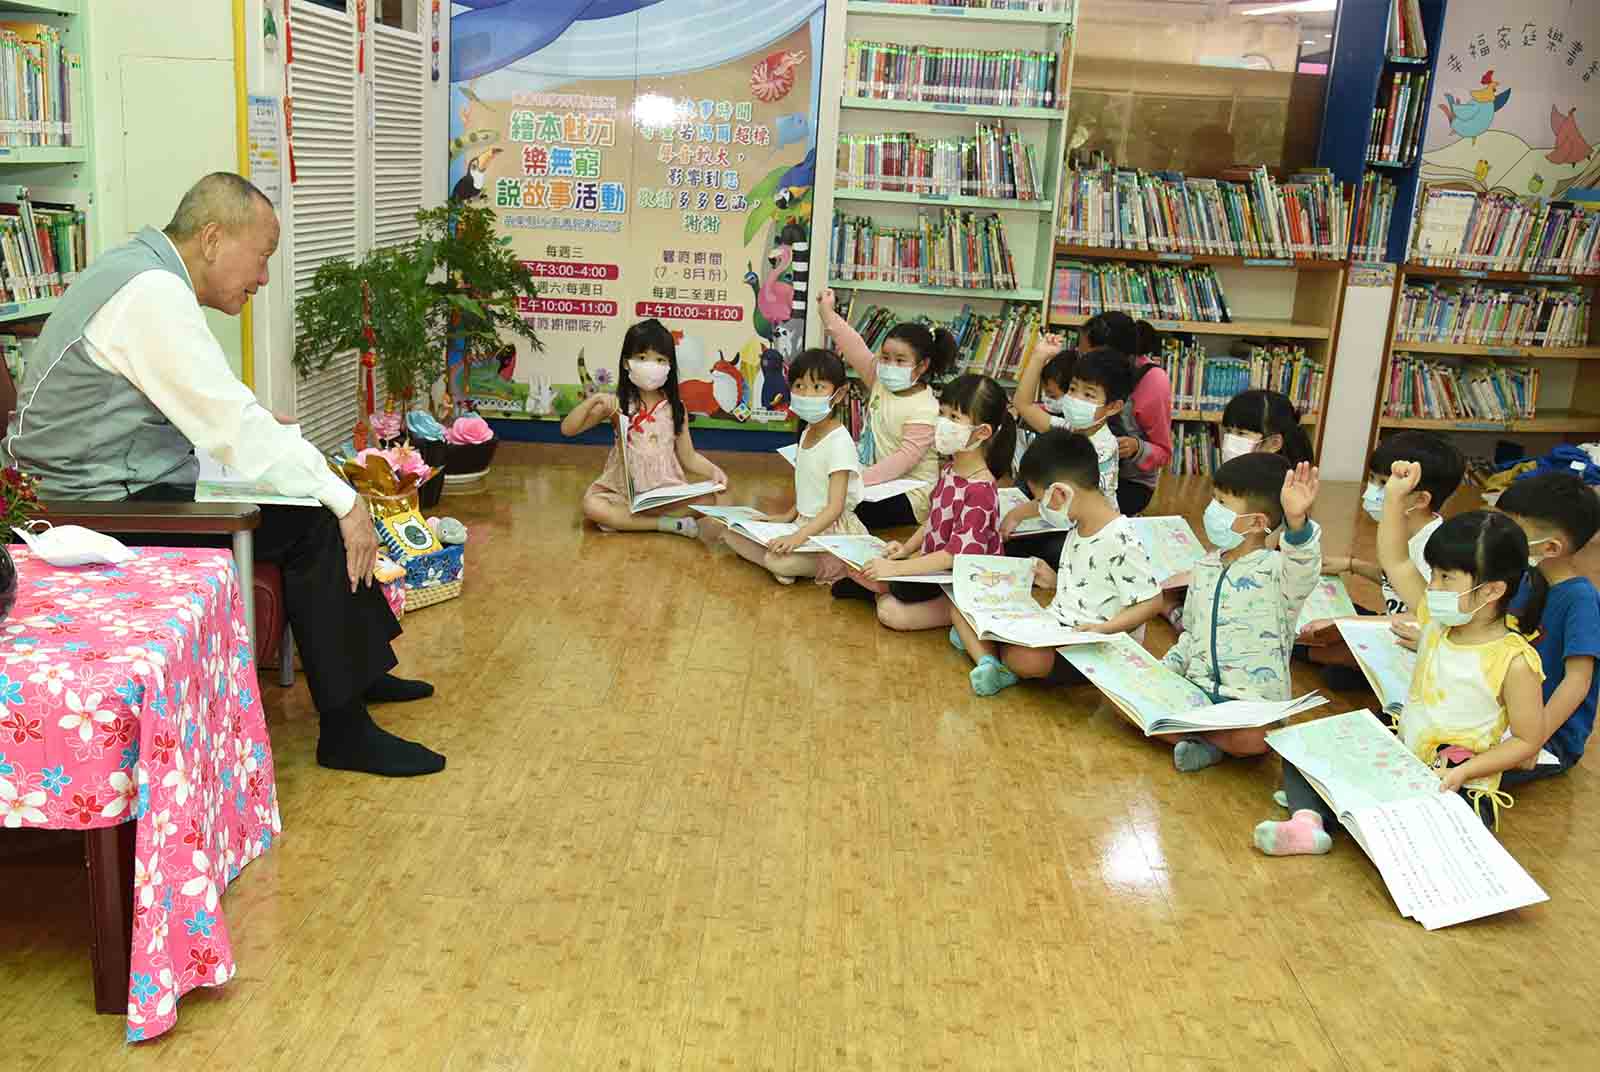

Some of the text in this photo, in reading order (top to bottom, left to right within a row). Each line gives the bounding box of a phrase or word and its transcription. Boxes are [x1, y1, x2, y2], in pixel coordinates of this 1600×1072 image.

[510, 111, 617, 146] 繪本魅力
[523, 144, 601, 178] 樂無窮
[683, 213, 721, 233] 謝謝
[546, 245, 585, 258] 每週三
[663, 249, 722, 265] 暑假期間
[536, 281, 603, 295] 週六/每週日
[652, 287, 728, 301] 每週二至週日
[640, 304, 739, 319] 上午10:00~11:00
